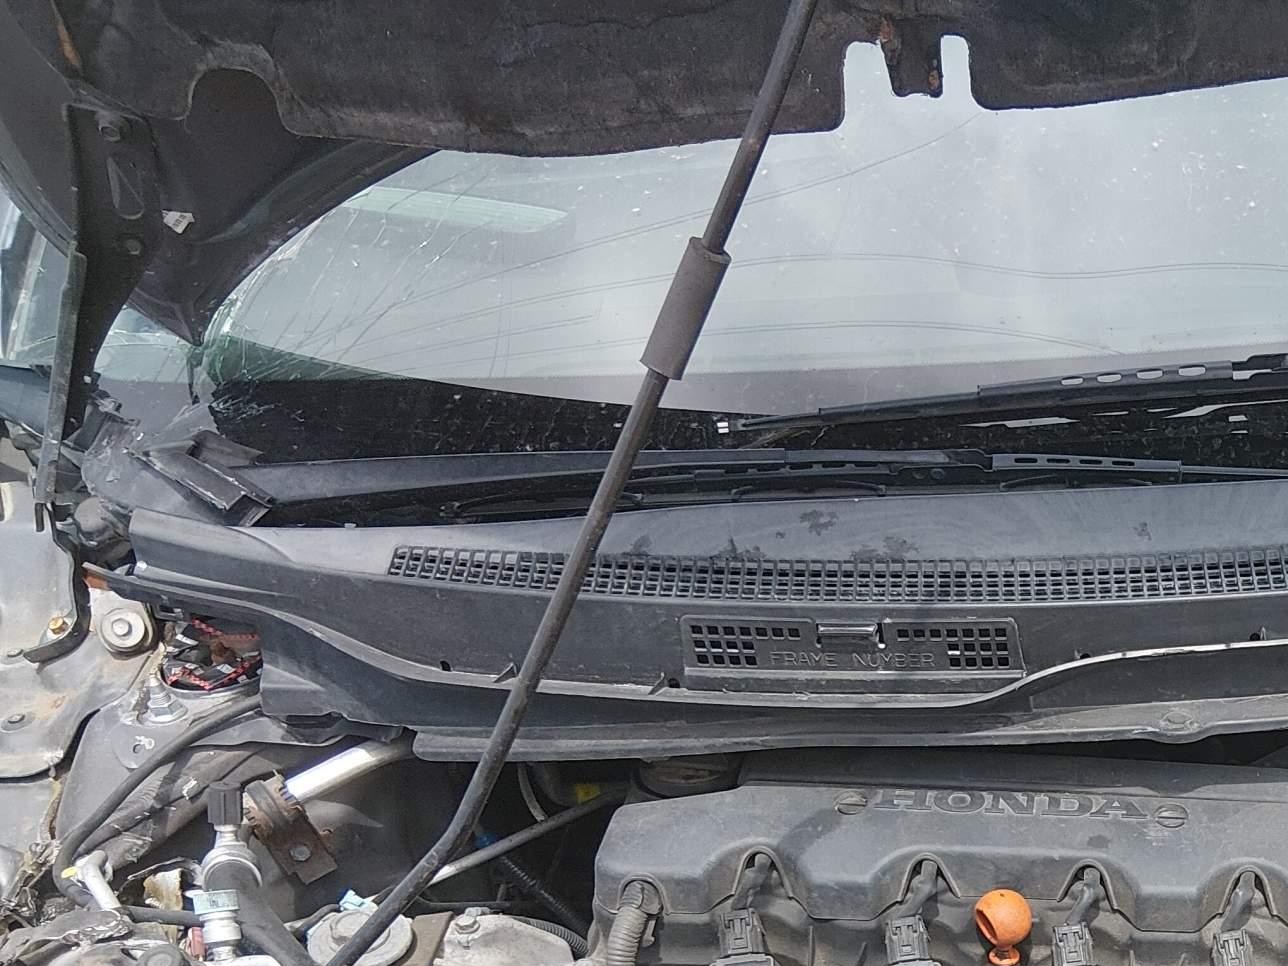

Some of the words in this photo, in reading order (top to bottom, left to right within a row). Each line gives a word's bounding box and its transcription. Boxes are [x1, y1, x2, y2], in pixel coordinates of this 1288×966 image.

[770, 651, 838, 667] FRAME
[851, 652, 936, 669] NUMBER
[872, 788, 1149, 820] HONDA
